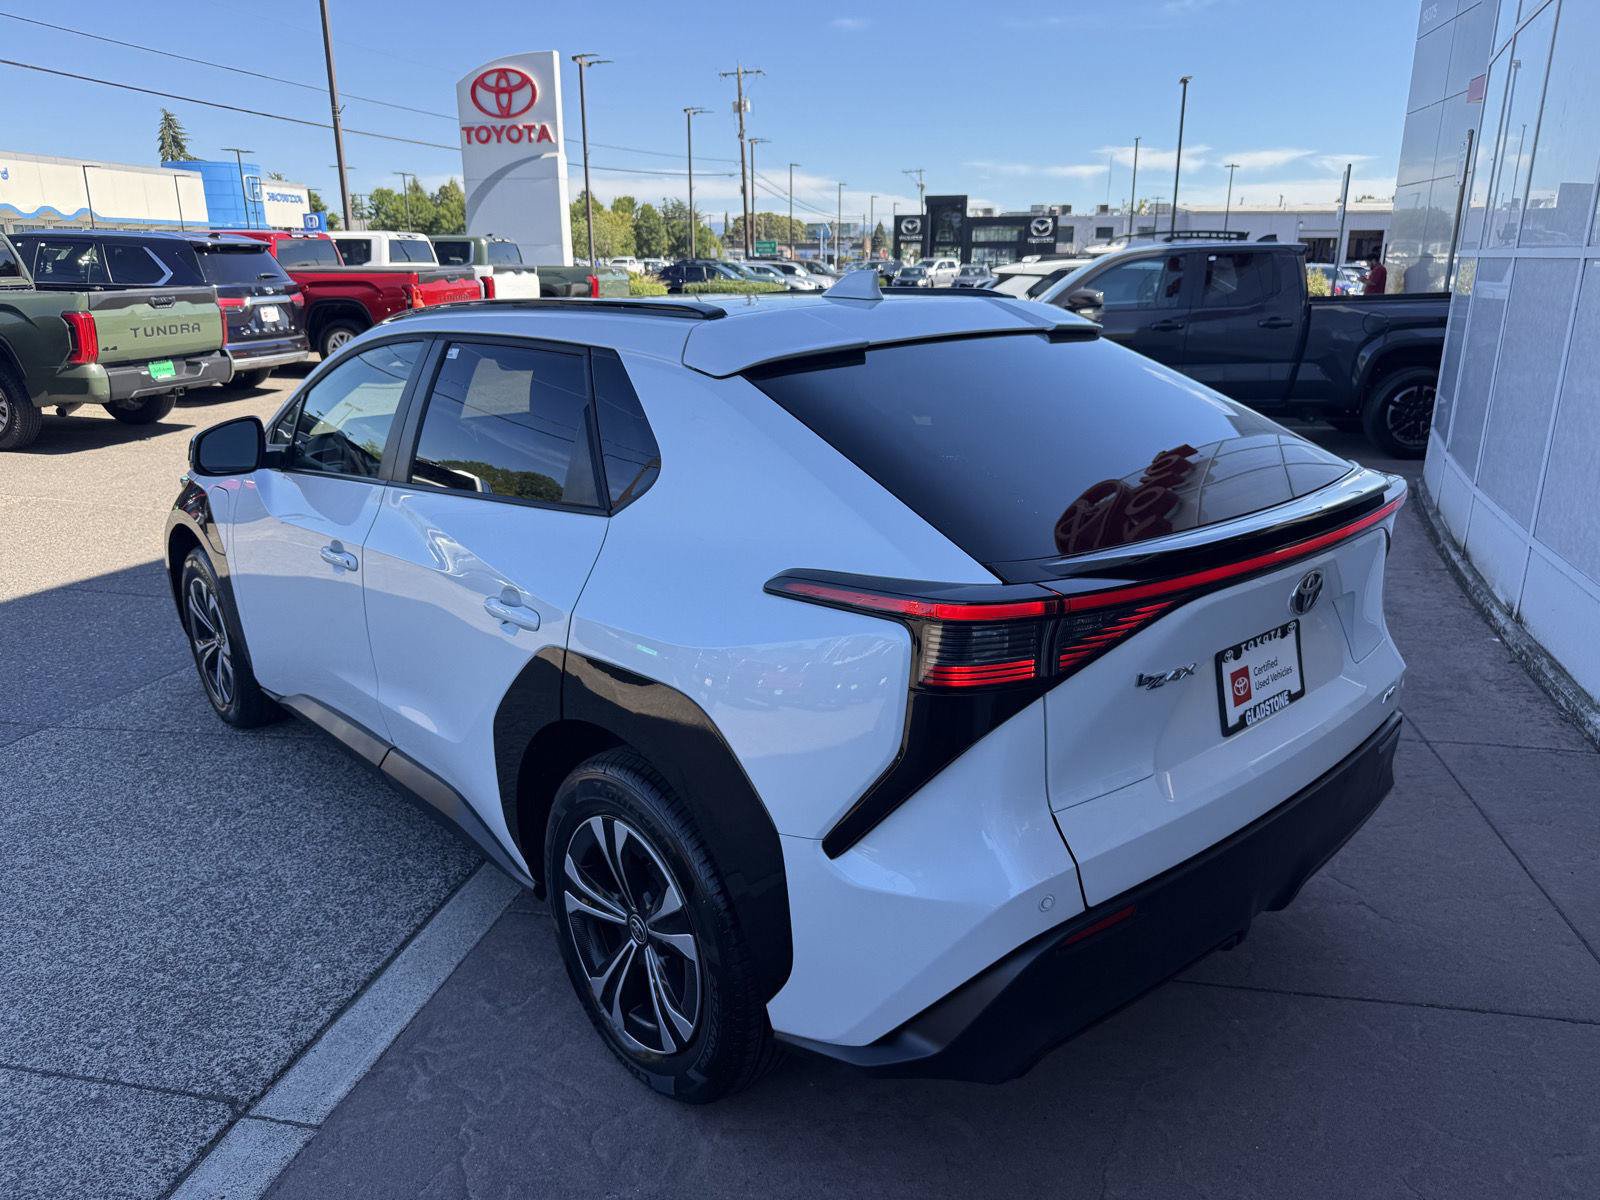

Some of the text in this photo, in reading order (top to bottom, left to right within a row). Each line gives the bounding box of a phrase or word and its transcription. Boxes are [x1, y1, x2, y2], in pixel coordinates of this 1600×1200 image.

[461, 124, 554, 144] TOYOTA
[130, 322, 201, 338] TUNDRA
[1241, 628, 1281, 652] TOYOTA
[1253, 656, 1278, 677] Certified
[1255, 665, 1293, 690] Used Vehicles
[1245, 690, 1290, 725] GLADSTONE
